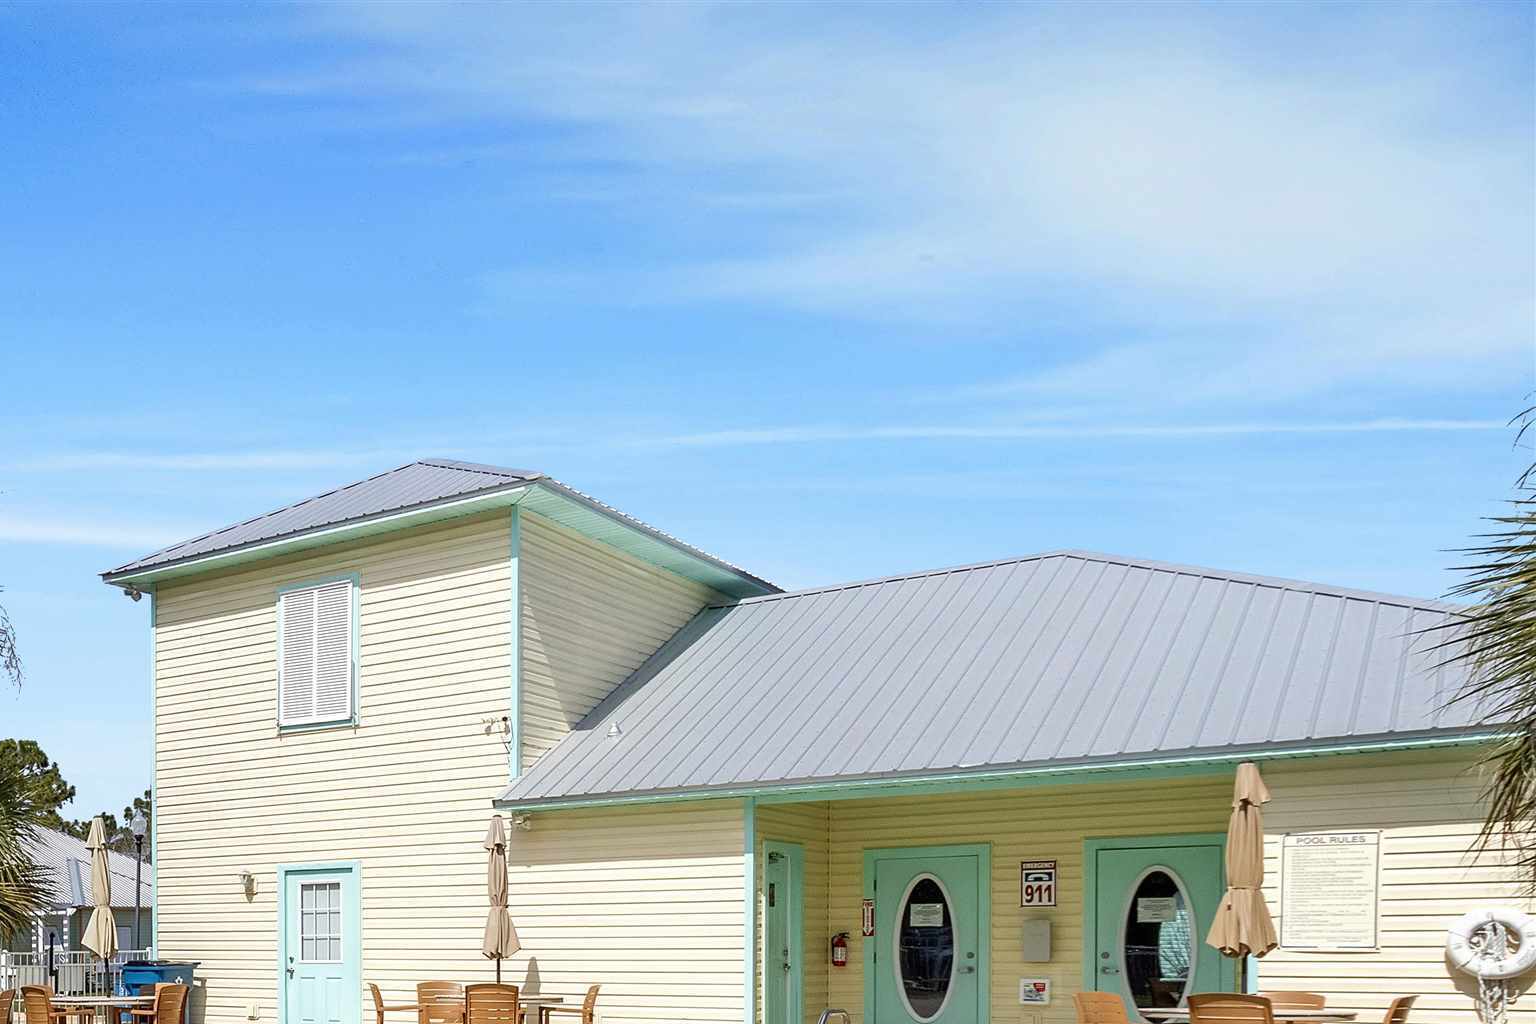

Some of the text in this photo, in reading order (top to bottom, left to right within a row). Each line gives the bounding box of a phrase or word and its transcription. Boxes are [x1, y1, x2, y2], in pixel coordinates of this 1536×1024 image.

[1296, 835, 1366, 845] POOL RULES
[1024, 884, 1052, 903] 911
